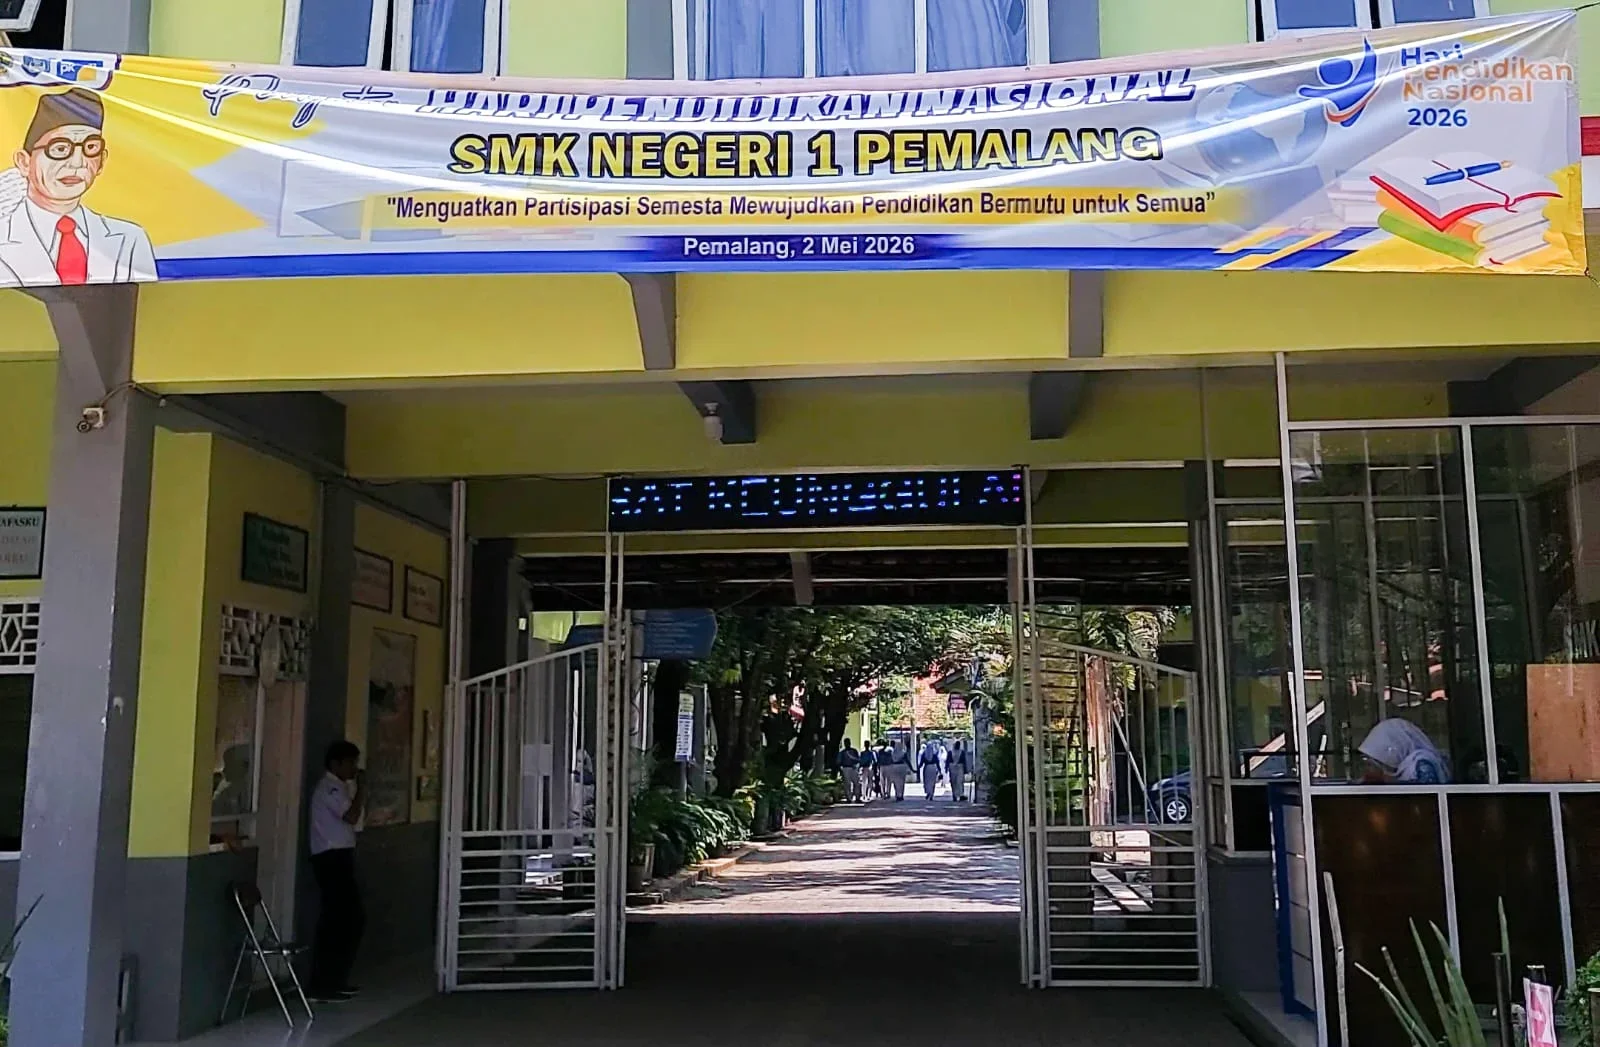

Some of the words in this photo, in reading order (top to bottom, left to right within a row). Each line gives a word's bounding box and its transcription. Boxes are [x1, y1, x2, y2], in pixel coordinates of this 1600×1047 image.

[1401, 44, 1463, 67] Hari
[911, 68, 1197, 118] NASIONAL
[1402, 79, 1533, 102] Nasional
[1408, 108, 1468, 127] 2026
[448, 132, 581, 177] SMK
[588, 131, 793, 178] NEGERI
[808, 130, 842, 177] 1
[854, 127, 1163, 176] PEMALANG
[388, 197, 517, 222] "Menguatkan
[525, 197, 631, 221] Partisipasi
[637, 197, 722, 216] Semesta
[730, 196, 854, 221] Mewujudkan
[862, 194, 973, 215] Pendidikan
[981, 192, 1065, 215] Bermutu
[1073, 194, 1130, 214] untuk
[684, 237, 796, 259] Pemalang,
[802, 237, 815, 255] 2
[821, 236, 859, 255] Mei
[865, 236, 915, 255] 2026
